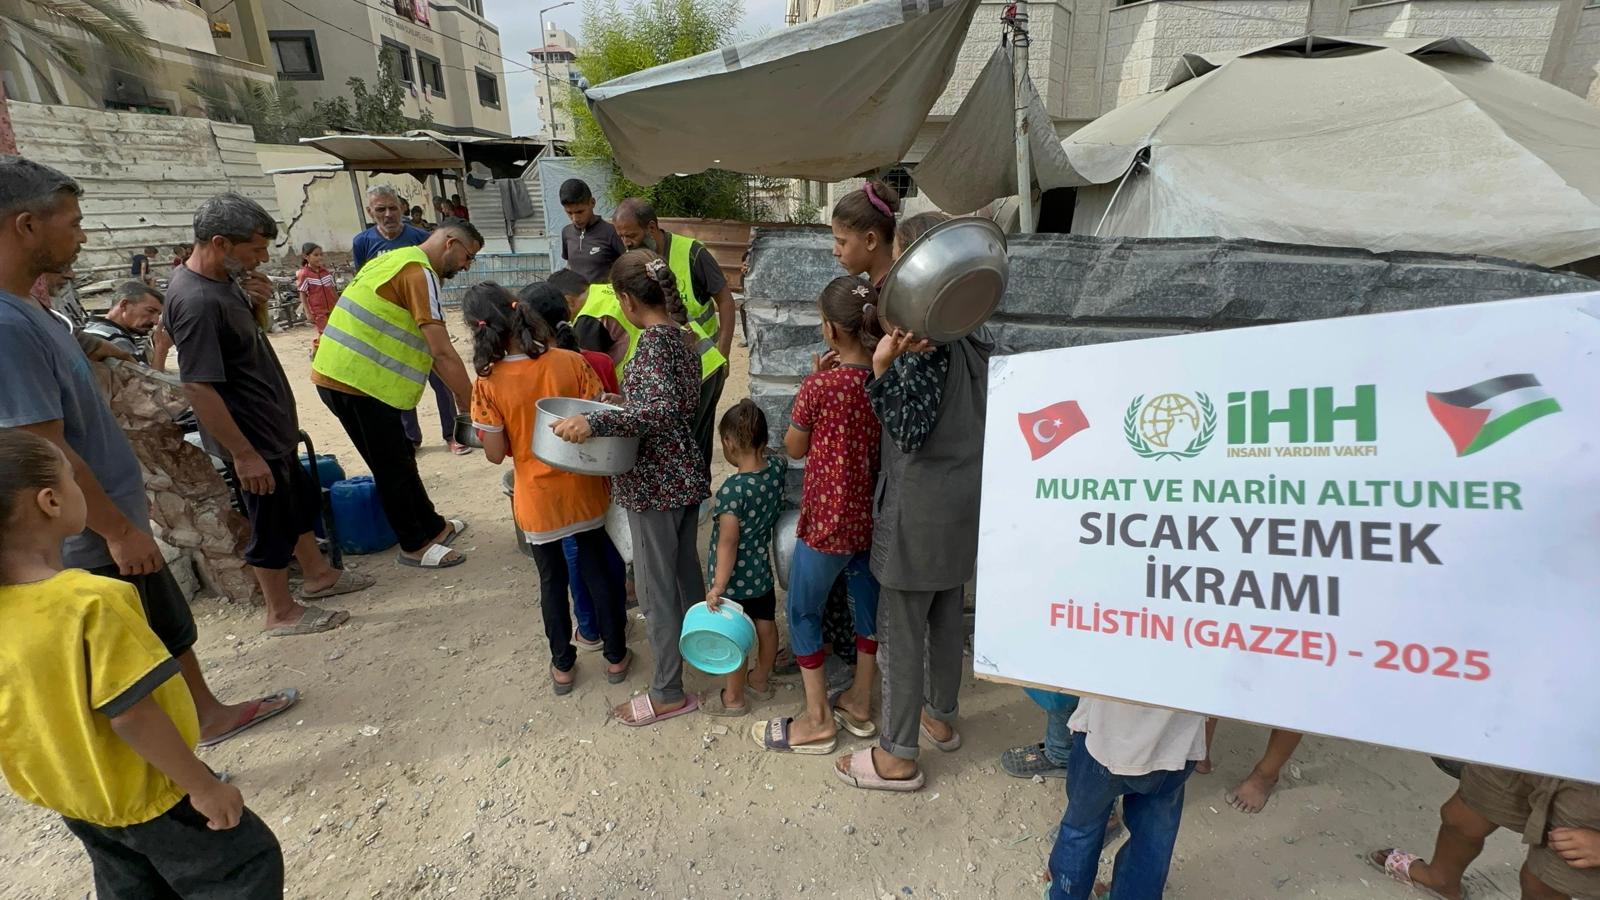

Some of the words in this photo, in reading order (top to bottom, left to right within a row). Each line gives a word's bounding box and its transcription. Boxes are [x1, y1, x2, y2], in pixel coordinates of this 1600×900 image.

[1275, 446, 1330, 457] YARDIM
[1333, 445, 1378, 457] VAKFI
[1035, 478, 1137, 501] MURAT
[1143, 479, 1183, 502] VE
[1193, 474, 1305, 505] NARİN
[1317, 480, 1524, 511] ALTUNER
[1079, 511, 1220, 552] SICAK
[1230, 516, 1444, 565] YEMEK
[1145, 554, 1340, 617] İKRAMI
[1050, 598, 1174, 642] FİLİSTİN
[1184, 617, 1337, 667] (GAZZE)
[1374, 639, 1491, 682] 2025
